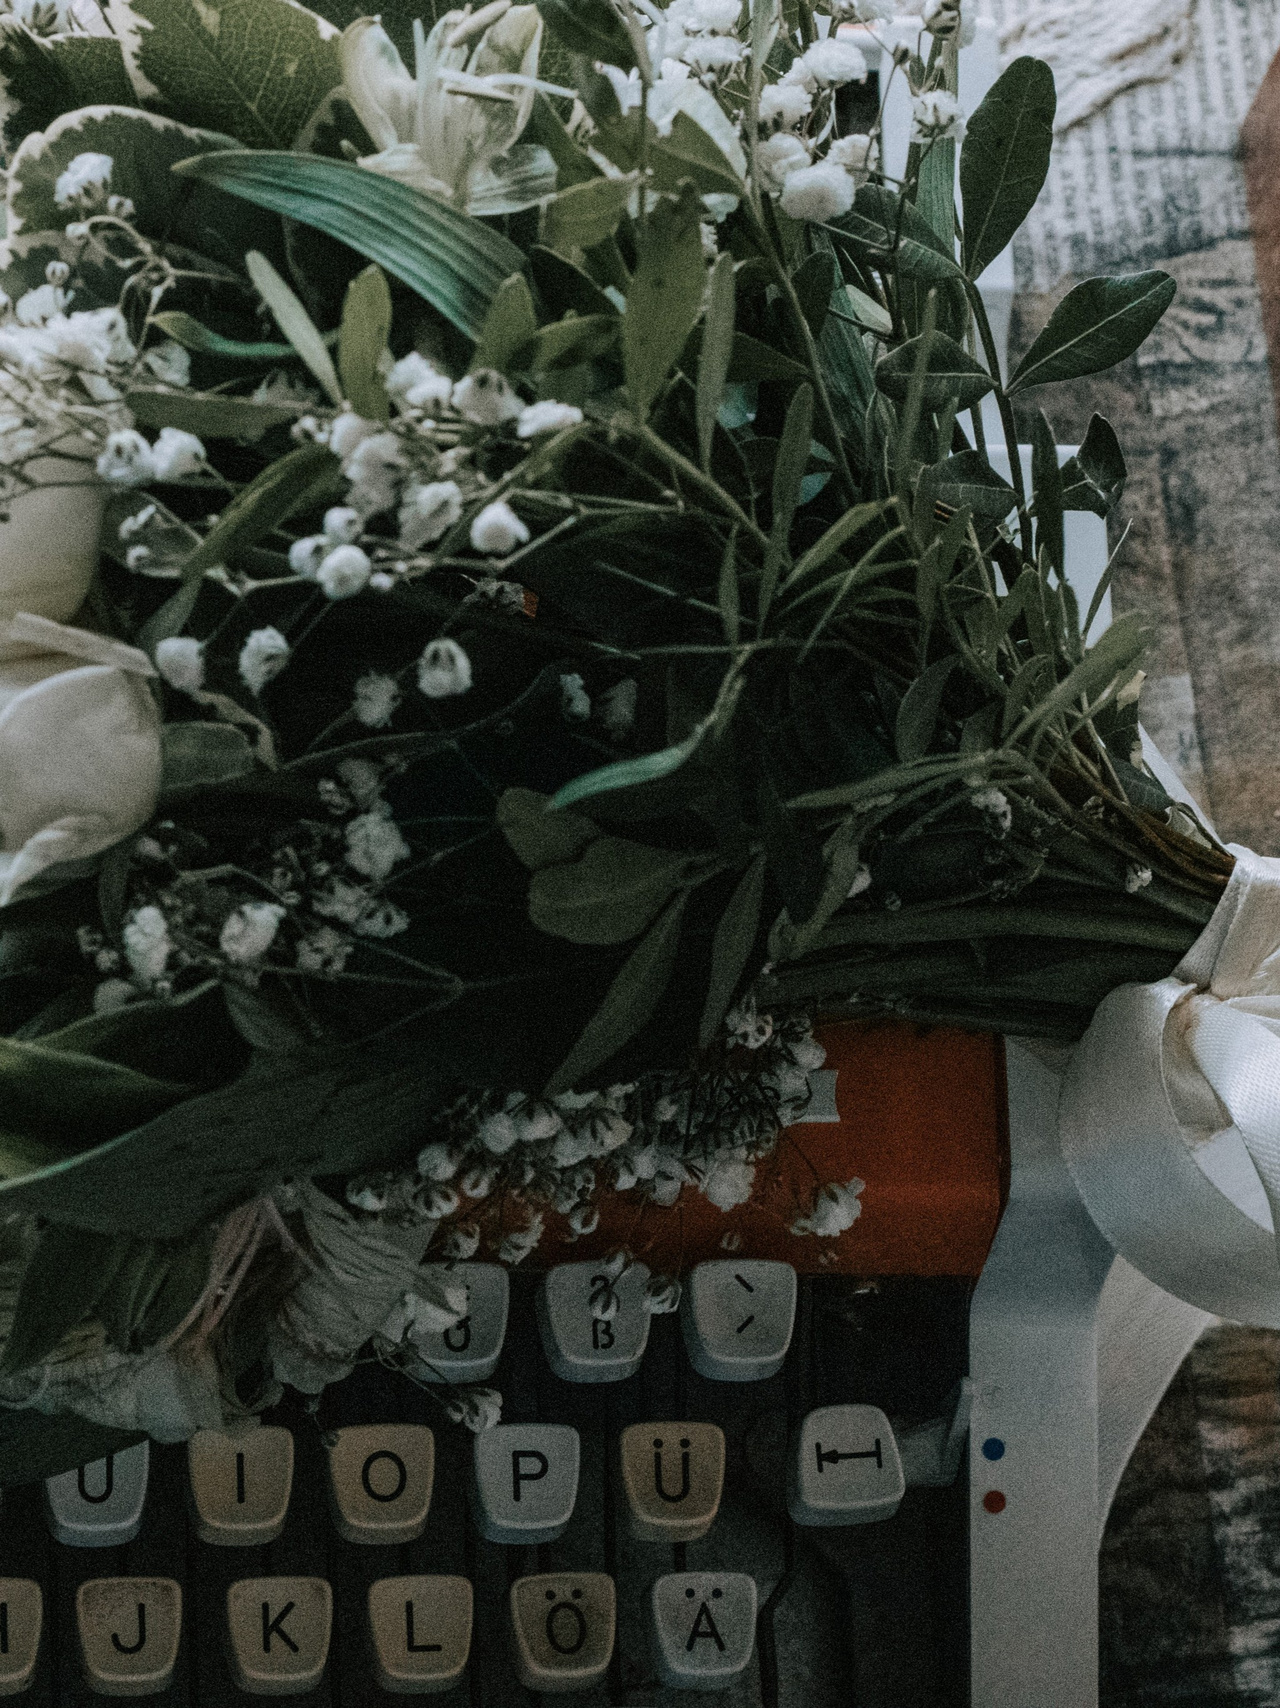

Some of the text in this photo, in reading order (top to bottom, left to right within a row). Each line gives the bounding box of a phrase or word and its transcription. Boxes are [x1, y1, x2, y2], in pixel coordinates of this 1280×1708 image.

[77, 1453, 114, 1504] U
[236, 1452, 246, 1505] I
[361, 1450, 408, 1504] O
[511, 1449, 549, 1503] P
[652, 1438, 692, 1504] Ü
[110, 1602, 147, 1655] J
[261, 1601, 300, 1654] K
[405, 1600, 443, 1653] L
[545, 1588, 588, 1656] Ö
[685, 1587, 727, 1653] Ä
